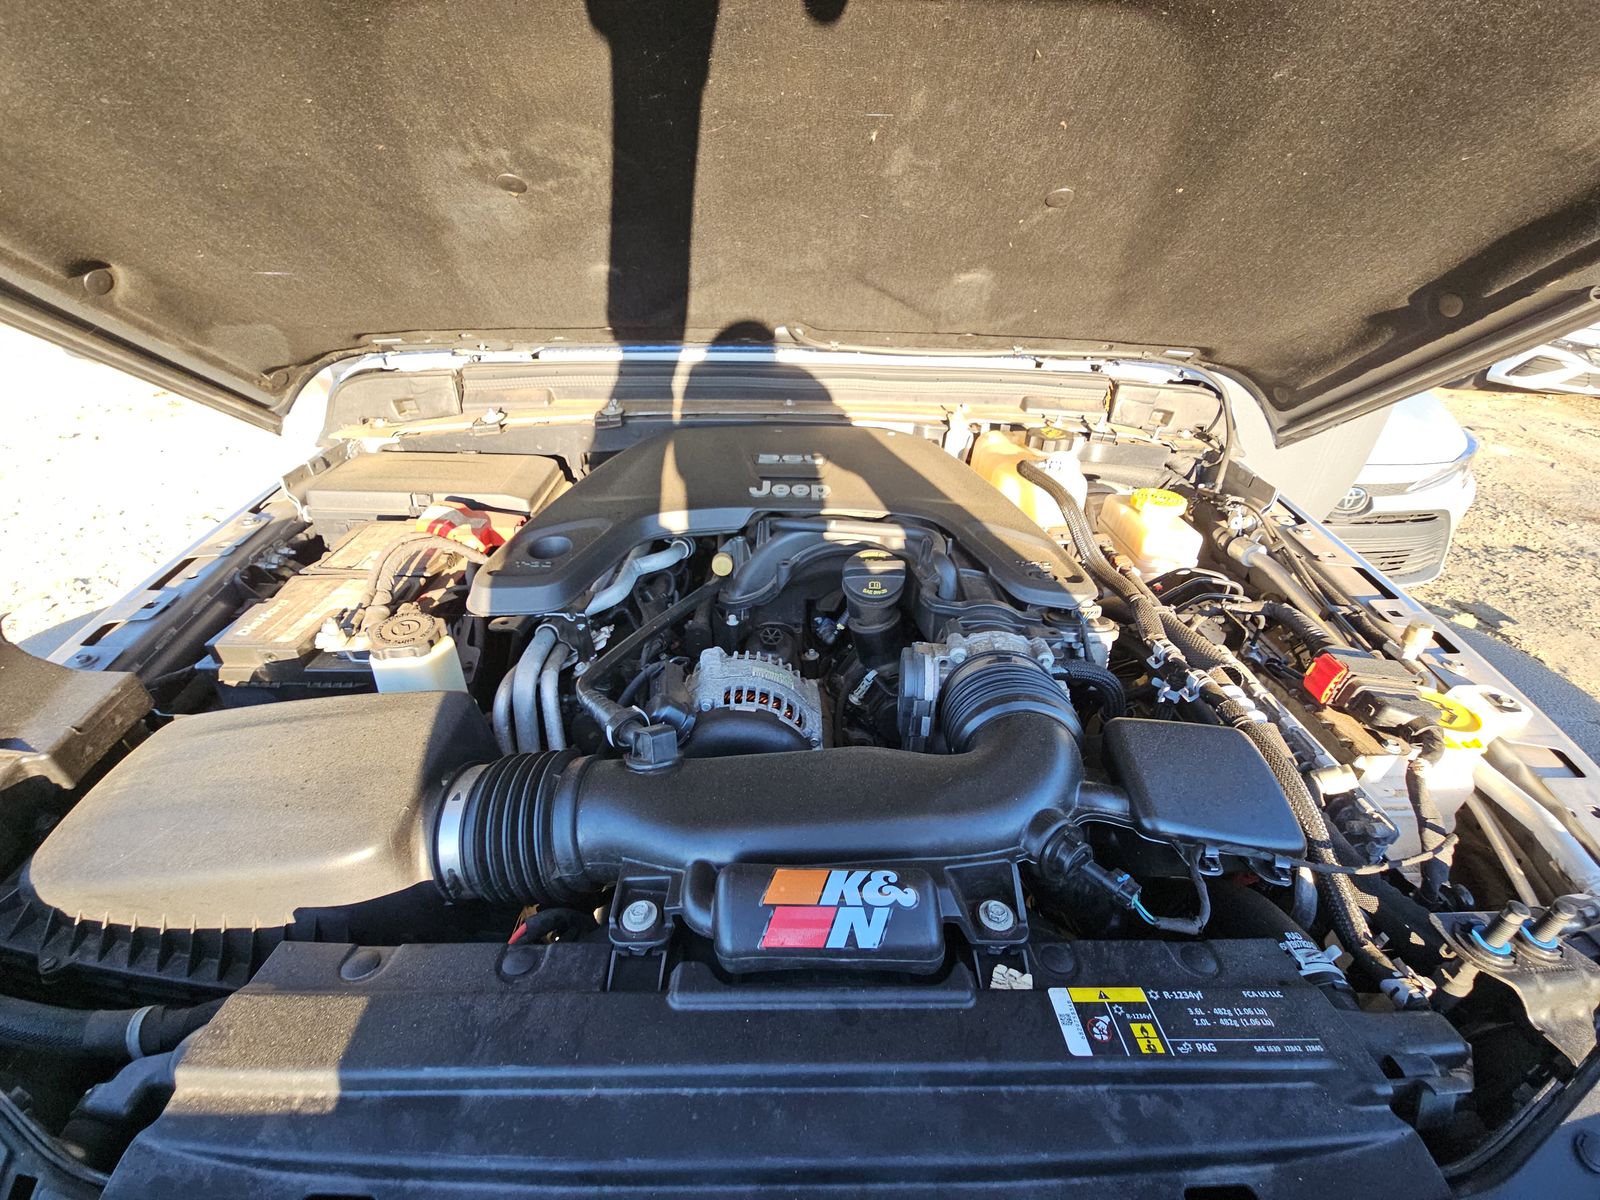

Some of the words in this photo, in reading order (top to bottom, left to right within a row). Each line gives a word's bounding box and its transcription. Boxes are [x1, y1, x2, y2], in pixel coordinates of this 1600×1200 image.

[749, 480, 832, 500] Jeep
[825, 907, 891, 949] N
[1163, 990, 1204, 1001] R-1234yf
[1242, 990, 1258, 998] FCA
[1259, 990, 1271, 998] US
[1271, 990, 1284, 998] LLC
[1195, 1043, 1218, 1053] PAG
